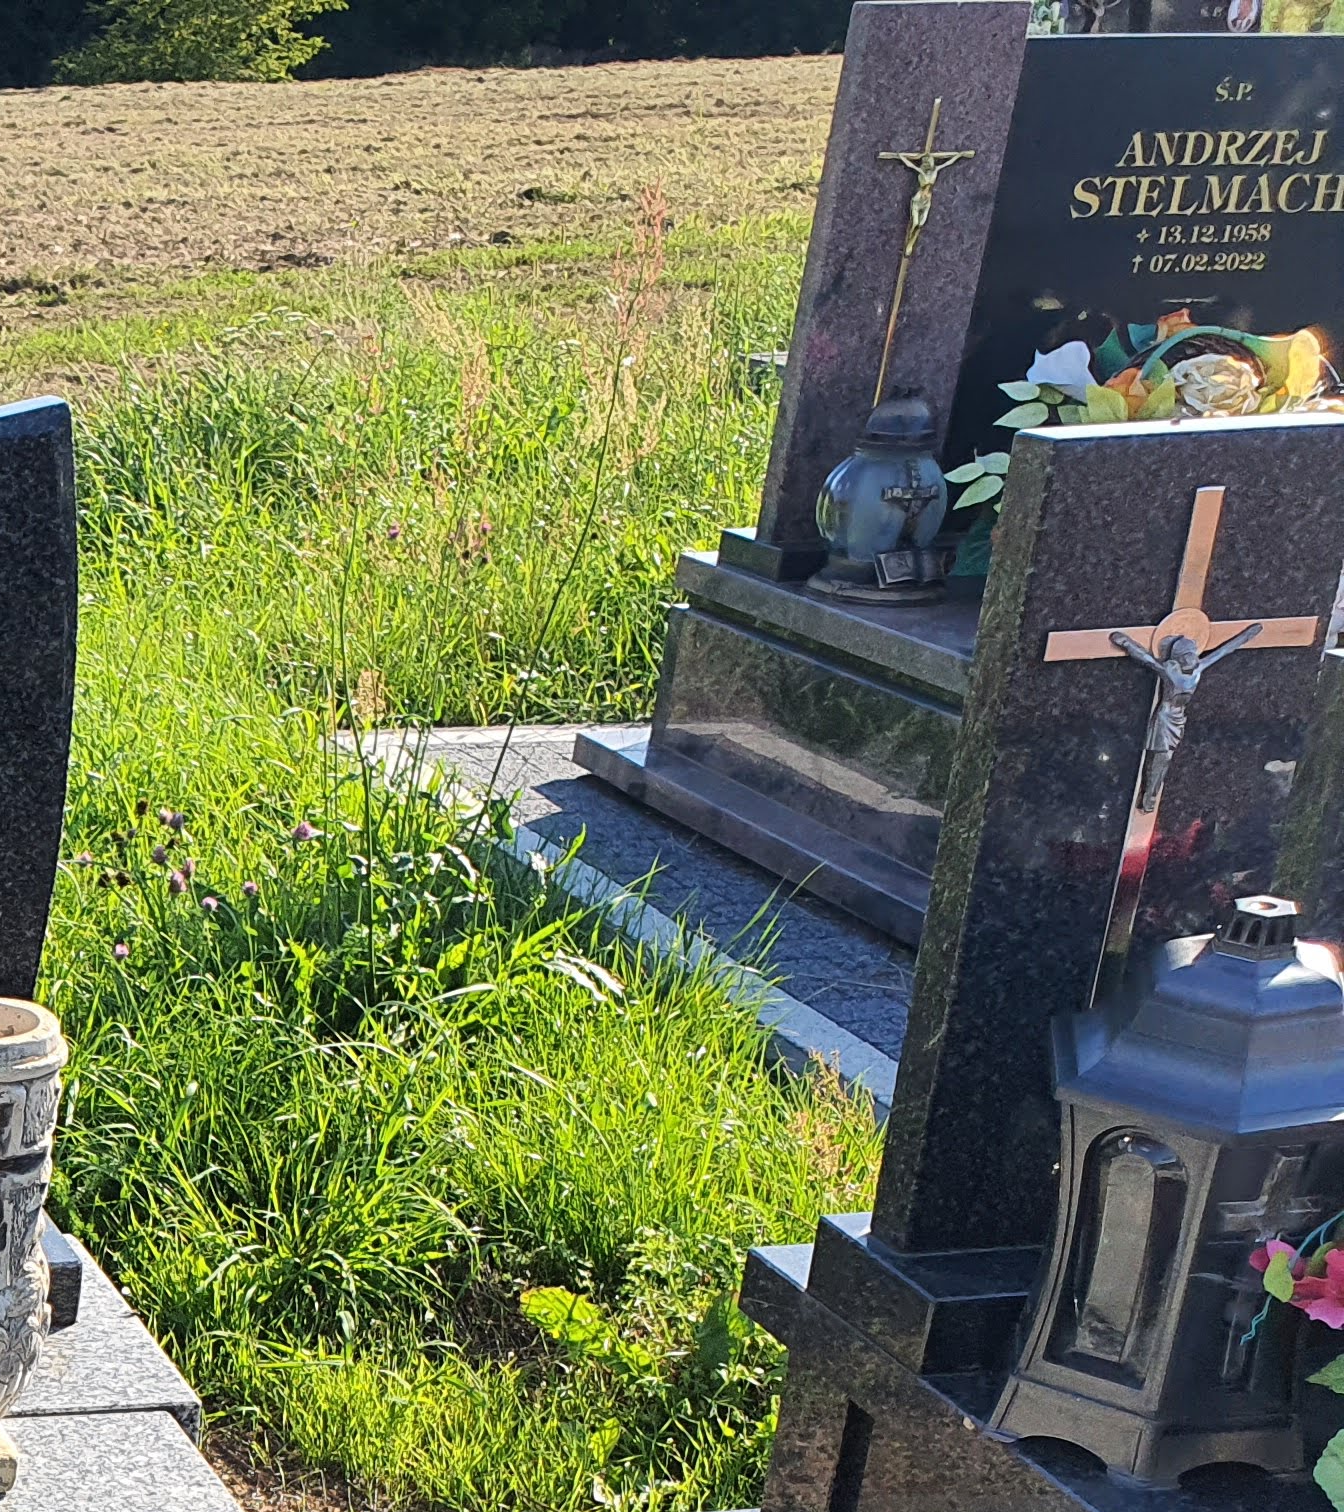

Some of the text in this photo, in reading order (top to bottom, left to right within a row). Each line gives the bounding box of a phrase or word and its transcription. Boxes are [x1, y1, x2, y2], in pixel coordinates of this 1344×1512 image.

[1115, 129, 1328, 167] ANDRZEJ
[1069, 173, 1344, 219] STELMACH
[1157, 223, 1272, 245] 13.12.1958
[1148, 252, 1266, 274] 07.02.2022
